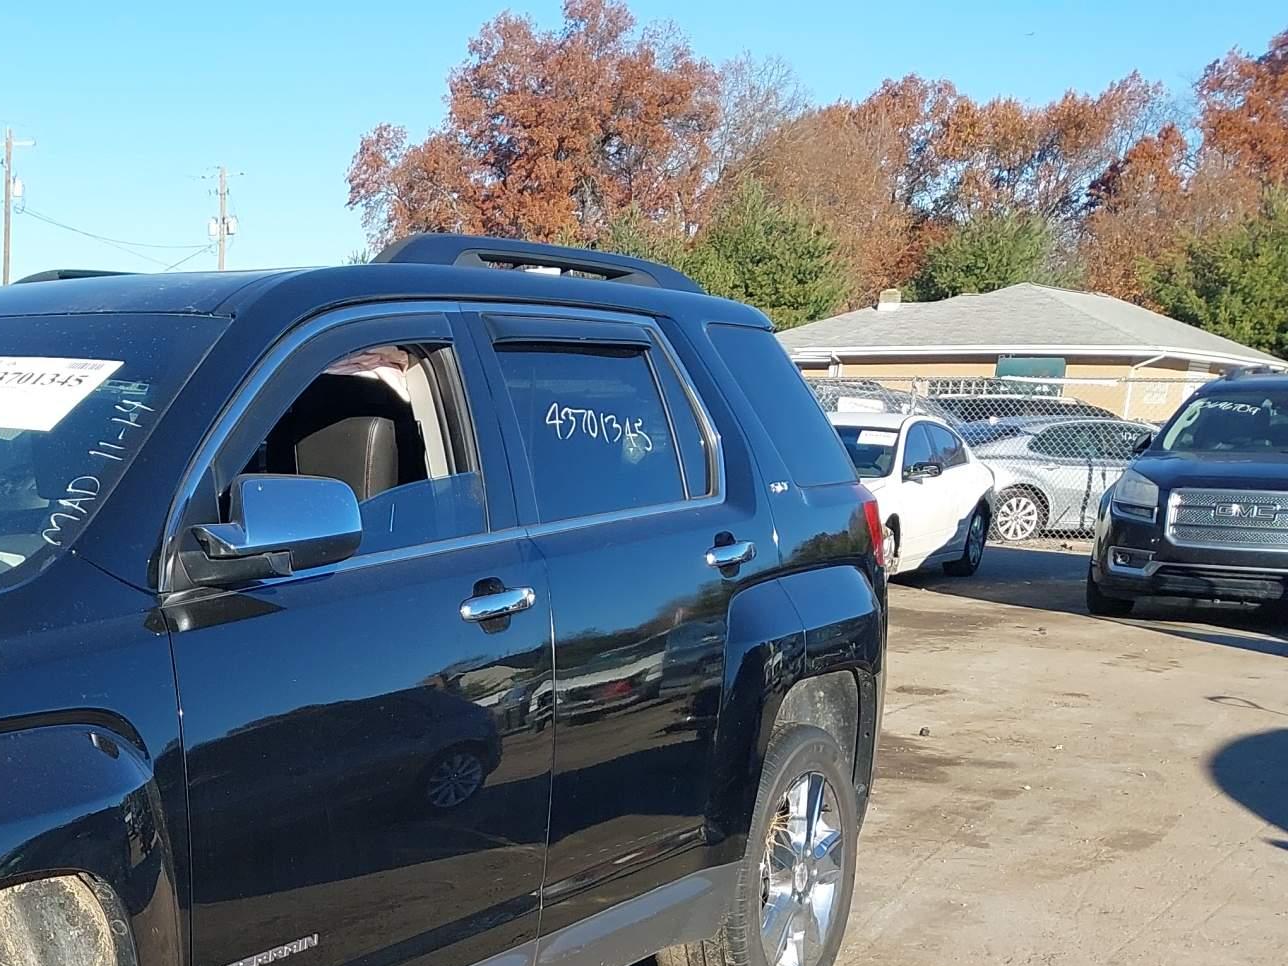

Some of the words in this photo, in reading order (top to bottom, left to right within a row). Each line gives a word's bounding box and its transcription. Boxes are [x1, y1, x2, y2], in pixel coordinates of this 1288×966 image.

[545, 402, 652, 452] 43701345
[41, 475, 101, 546] MAD
[88, 399, 156, 461] 11-14
[1214, 503, 1276, 519] GMC
